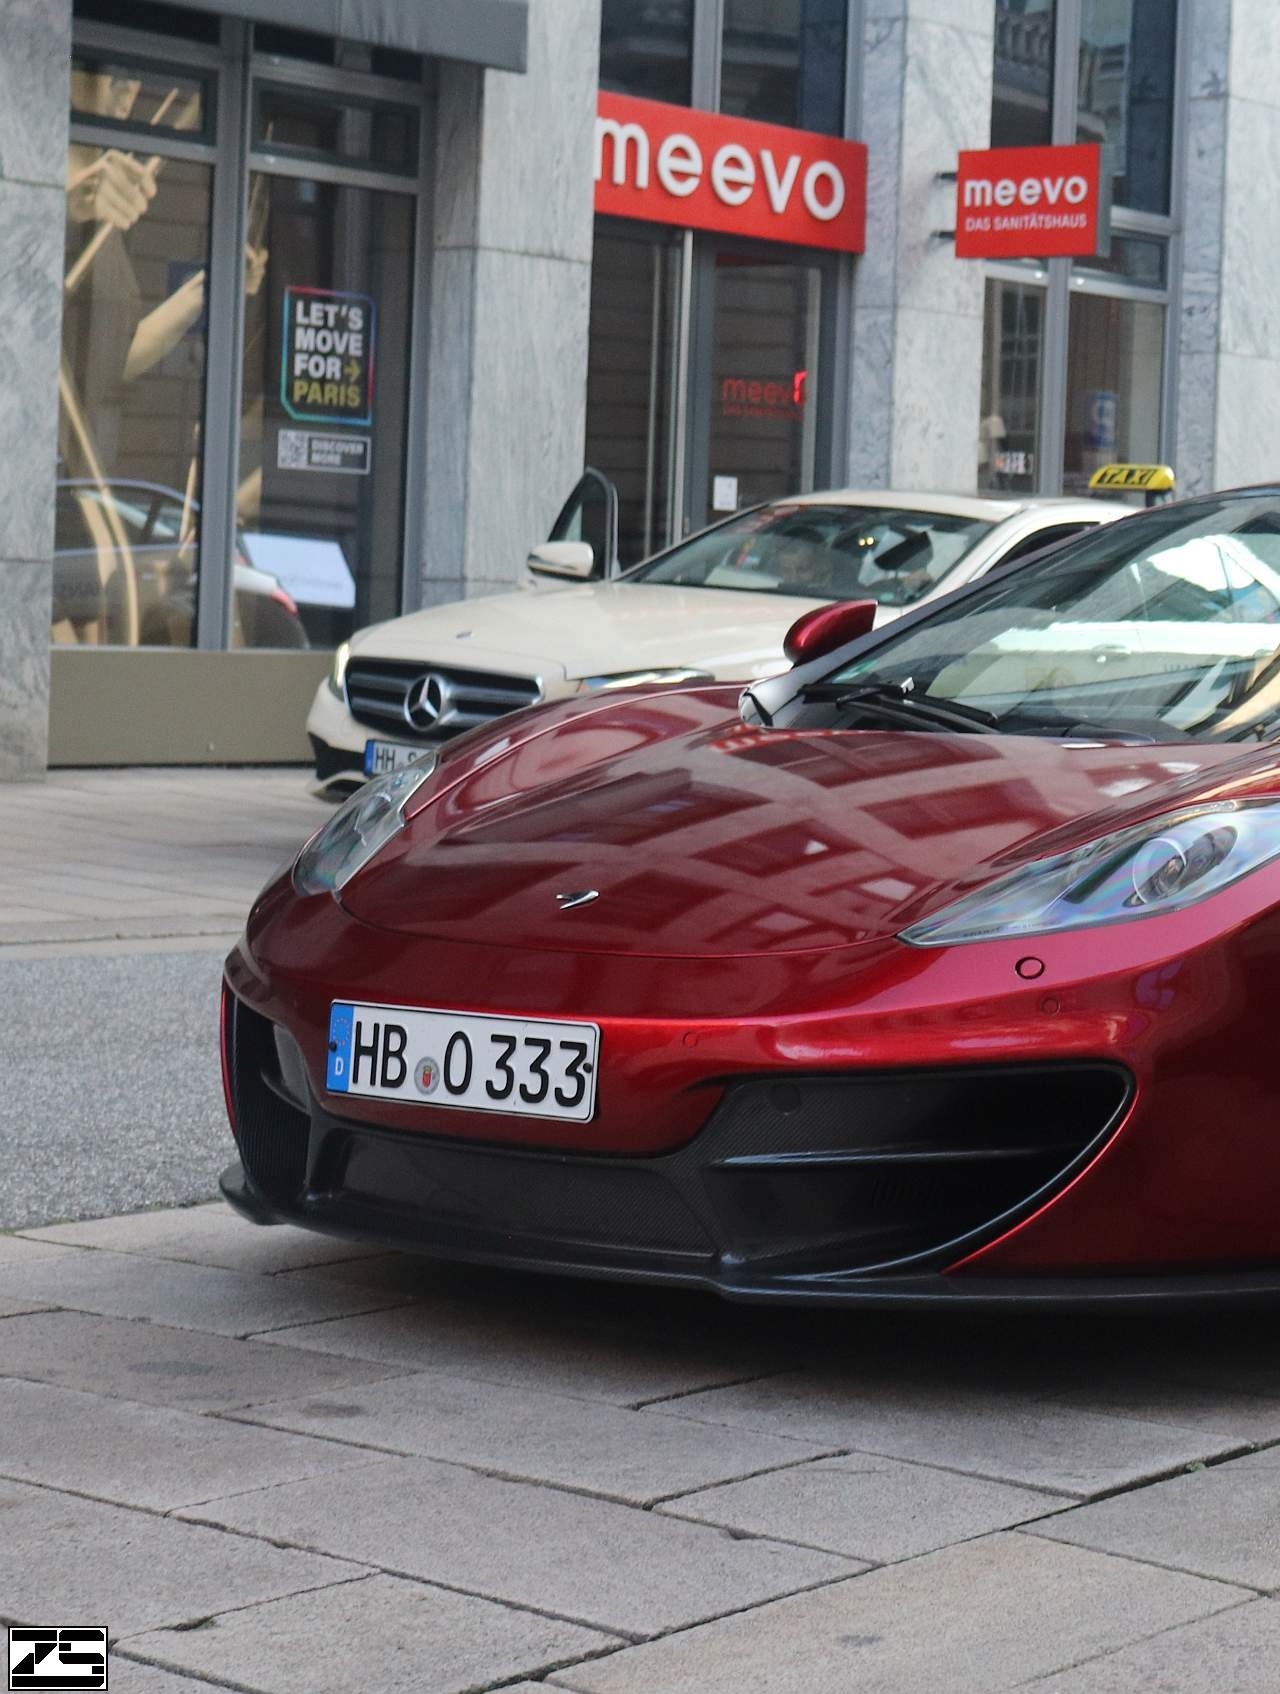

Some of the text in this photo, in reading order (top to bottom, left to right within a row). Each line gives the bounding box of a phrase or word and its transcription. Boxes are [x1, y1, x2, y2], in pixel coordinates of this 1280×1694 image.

[594, 117, 845, 221] meevo
[964, 176, 1088, 207] meevo
[965, 212, 1087, 232] DAS SANITÄTSHAUS
[295, 300, 364, 331] LET'S
[295, 326, 364, 358] MOVE
[293, 352, 342, 380] FOR
[292, 379, 361, 408] PARIS
[1097, 469, 1157, 486] TAXI
[334, 1056, 344, 1077] D
[352, 1021, 408, 1089] HB
[485, 1033, 588, 1108] 333
